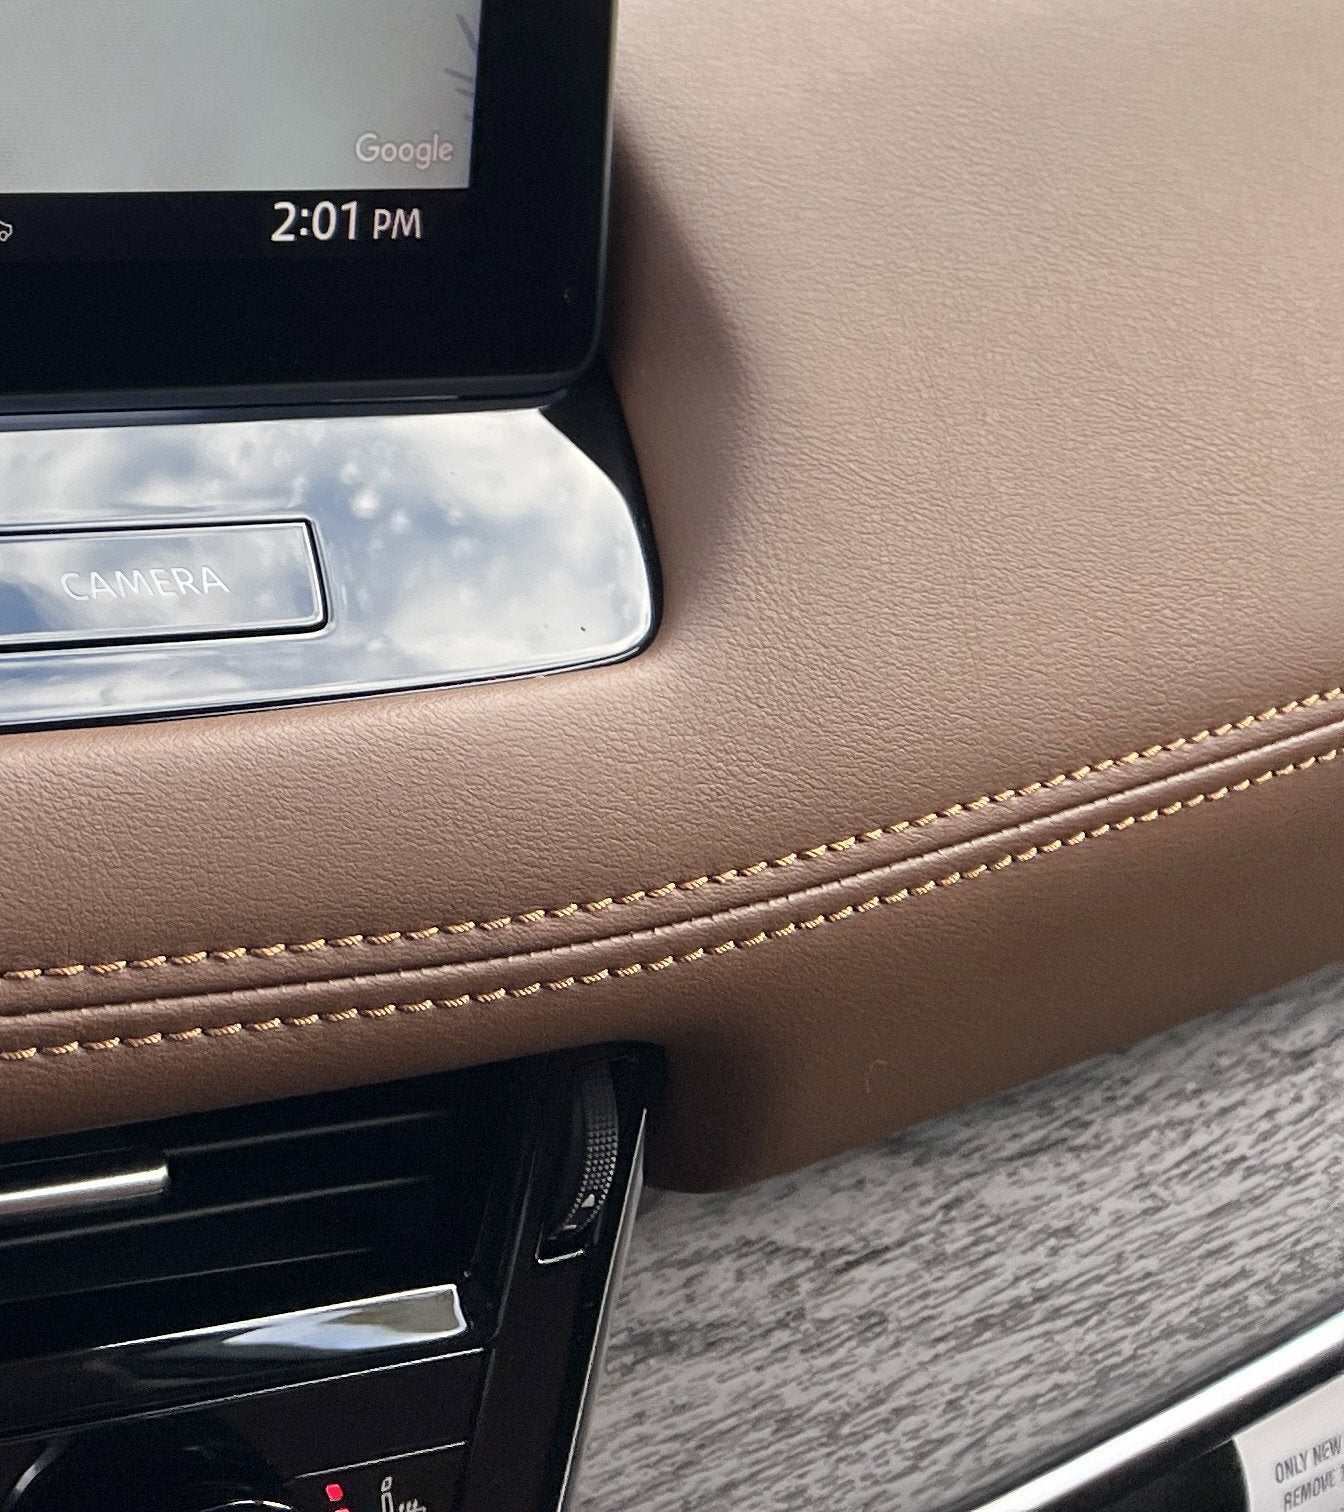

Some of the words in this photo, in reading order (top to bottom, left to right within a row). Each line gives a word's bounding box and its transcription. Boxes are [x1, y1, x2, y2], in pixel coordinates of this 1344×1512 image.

[355, 132, 454, 170] Google
[270, 199, 359, 243] 2:01
[372, 207, 423, 241] PM
[59, 563, 232, 603] CAMERA
[1274, 1449, 1309, 1484] ONLY
[1312, 1434, 1342, 1467] NEW
[1283, 1467, 1336, 1512] REMOVE
